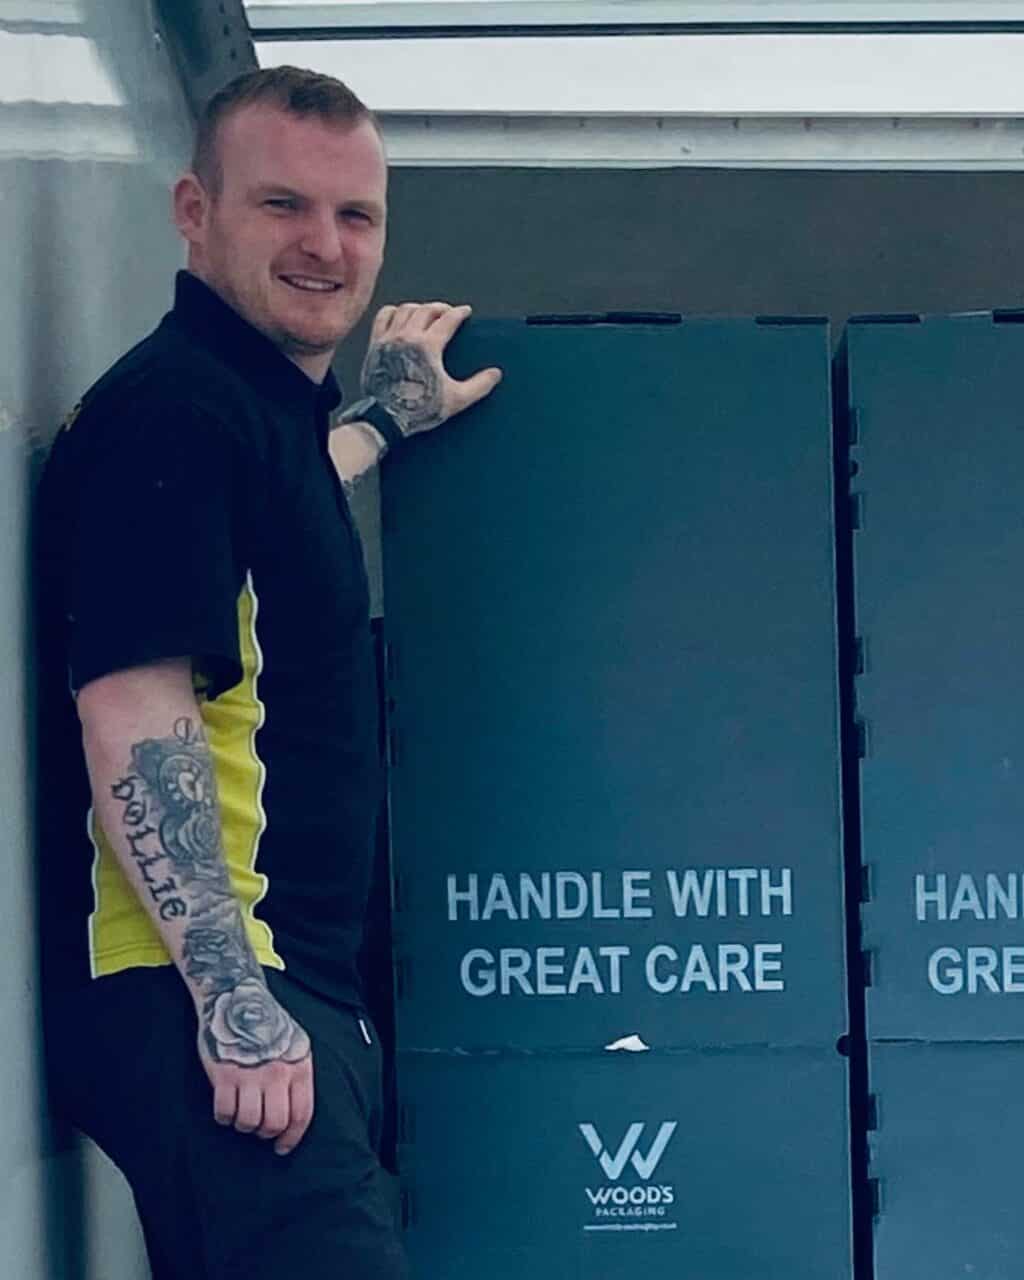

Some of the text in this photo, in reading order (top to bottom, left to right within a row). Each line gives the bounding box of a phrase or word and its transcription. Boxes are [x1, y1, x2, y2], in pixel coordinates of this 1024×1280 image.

[448, 869, 791, 920] HANDLE WITH
[461, 944, 783, 995] GREAT CARE
[585, 1185, 674, 1205] WOOD'S
[596, 1206, 665, 1217] PACKAGING
